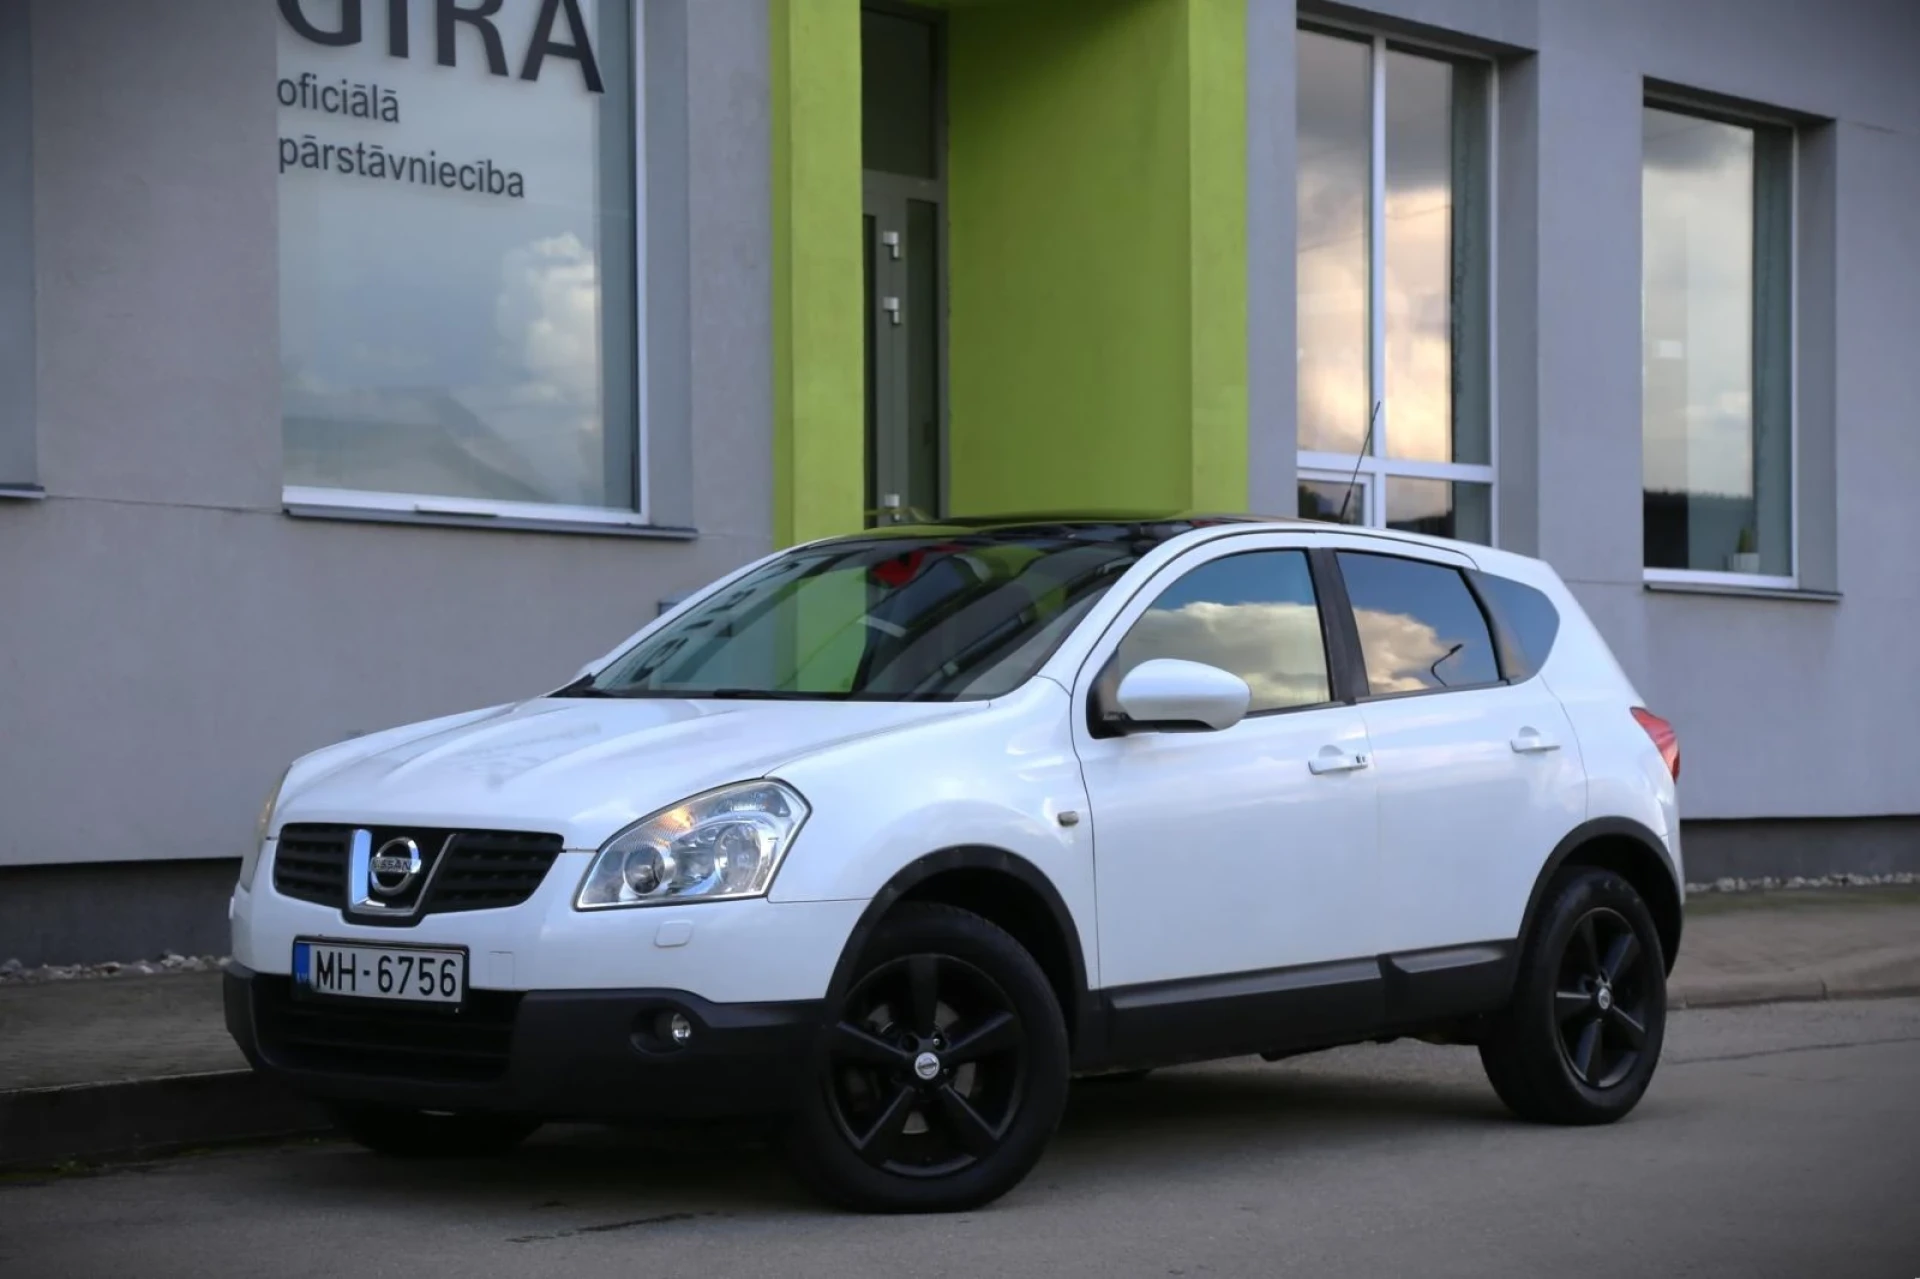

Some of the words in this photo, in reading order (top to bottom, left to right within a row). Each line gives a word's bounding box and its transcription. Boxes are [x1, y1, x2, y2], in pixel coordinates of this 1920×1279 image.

[277, 73, 399, 123] oficiālā
[279, 135, 524, 198] pārstāvniecība
[316, 950, 456, 997] MH-6756
